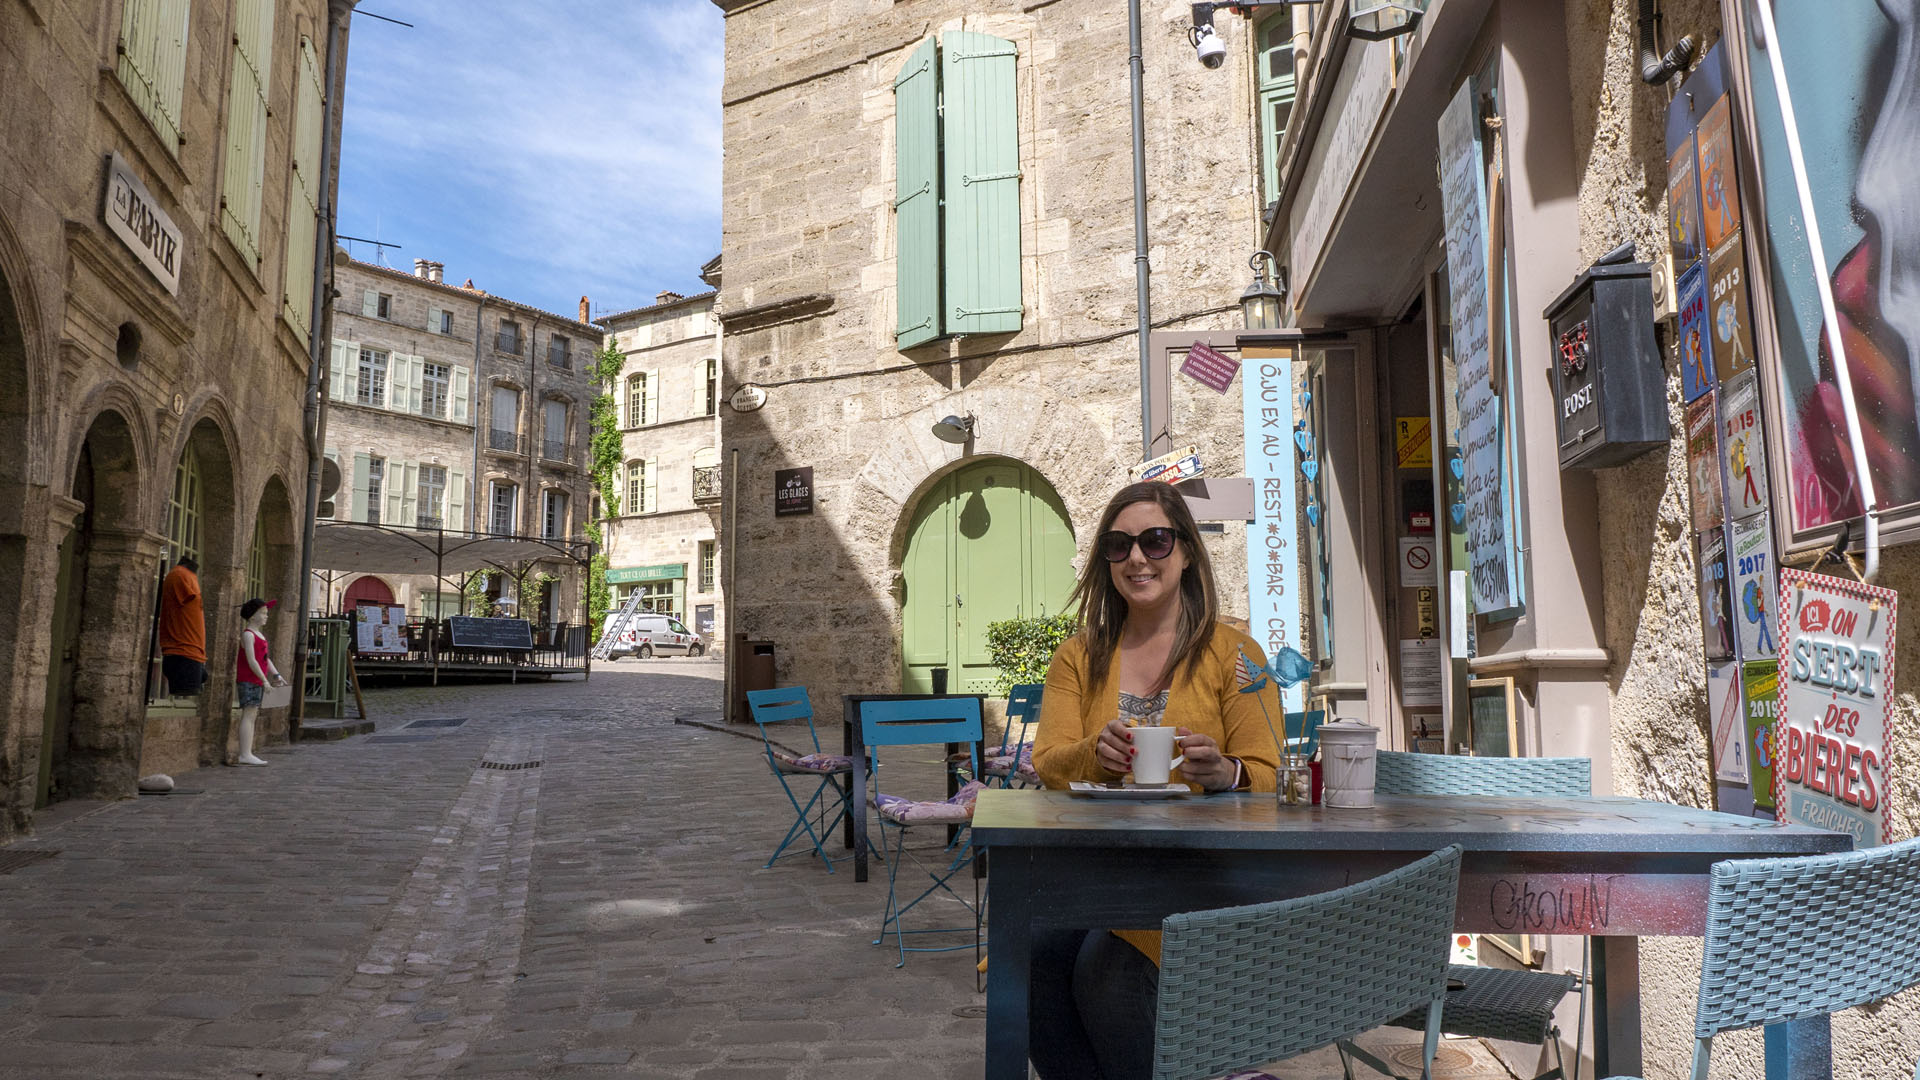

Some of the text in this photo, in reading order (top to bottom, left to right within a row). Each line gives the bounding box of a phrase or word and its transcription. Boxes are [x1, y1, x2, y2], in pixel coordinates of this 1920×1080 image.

[116, 185, 176, 278] LA FABRIK
[1713, 267, 1740, 302] 2013
[1682, 296, 1703, 327] 2014
[1564, 383, 1592, 418] POST
[1728, 409, 1754, 437] 2015
[1262, 433, 1280, 457] AU
[1703, 561, 1724, 582] 2018
[1739, 553, 1766, 576] 2017
[1807, 606, 1858, 638] ICI ON
[1792, 639, 1880, 698] SERT
[1750, 700, 1778, 718] 2019
[1823, 704, 1860, 738] DES
[1735, 742, 1743, 766] R
[1787, 720, 1879, 812] BIÈRES
[1801, 800, 1865, 843] FRAÎCHES
